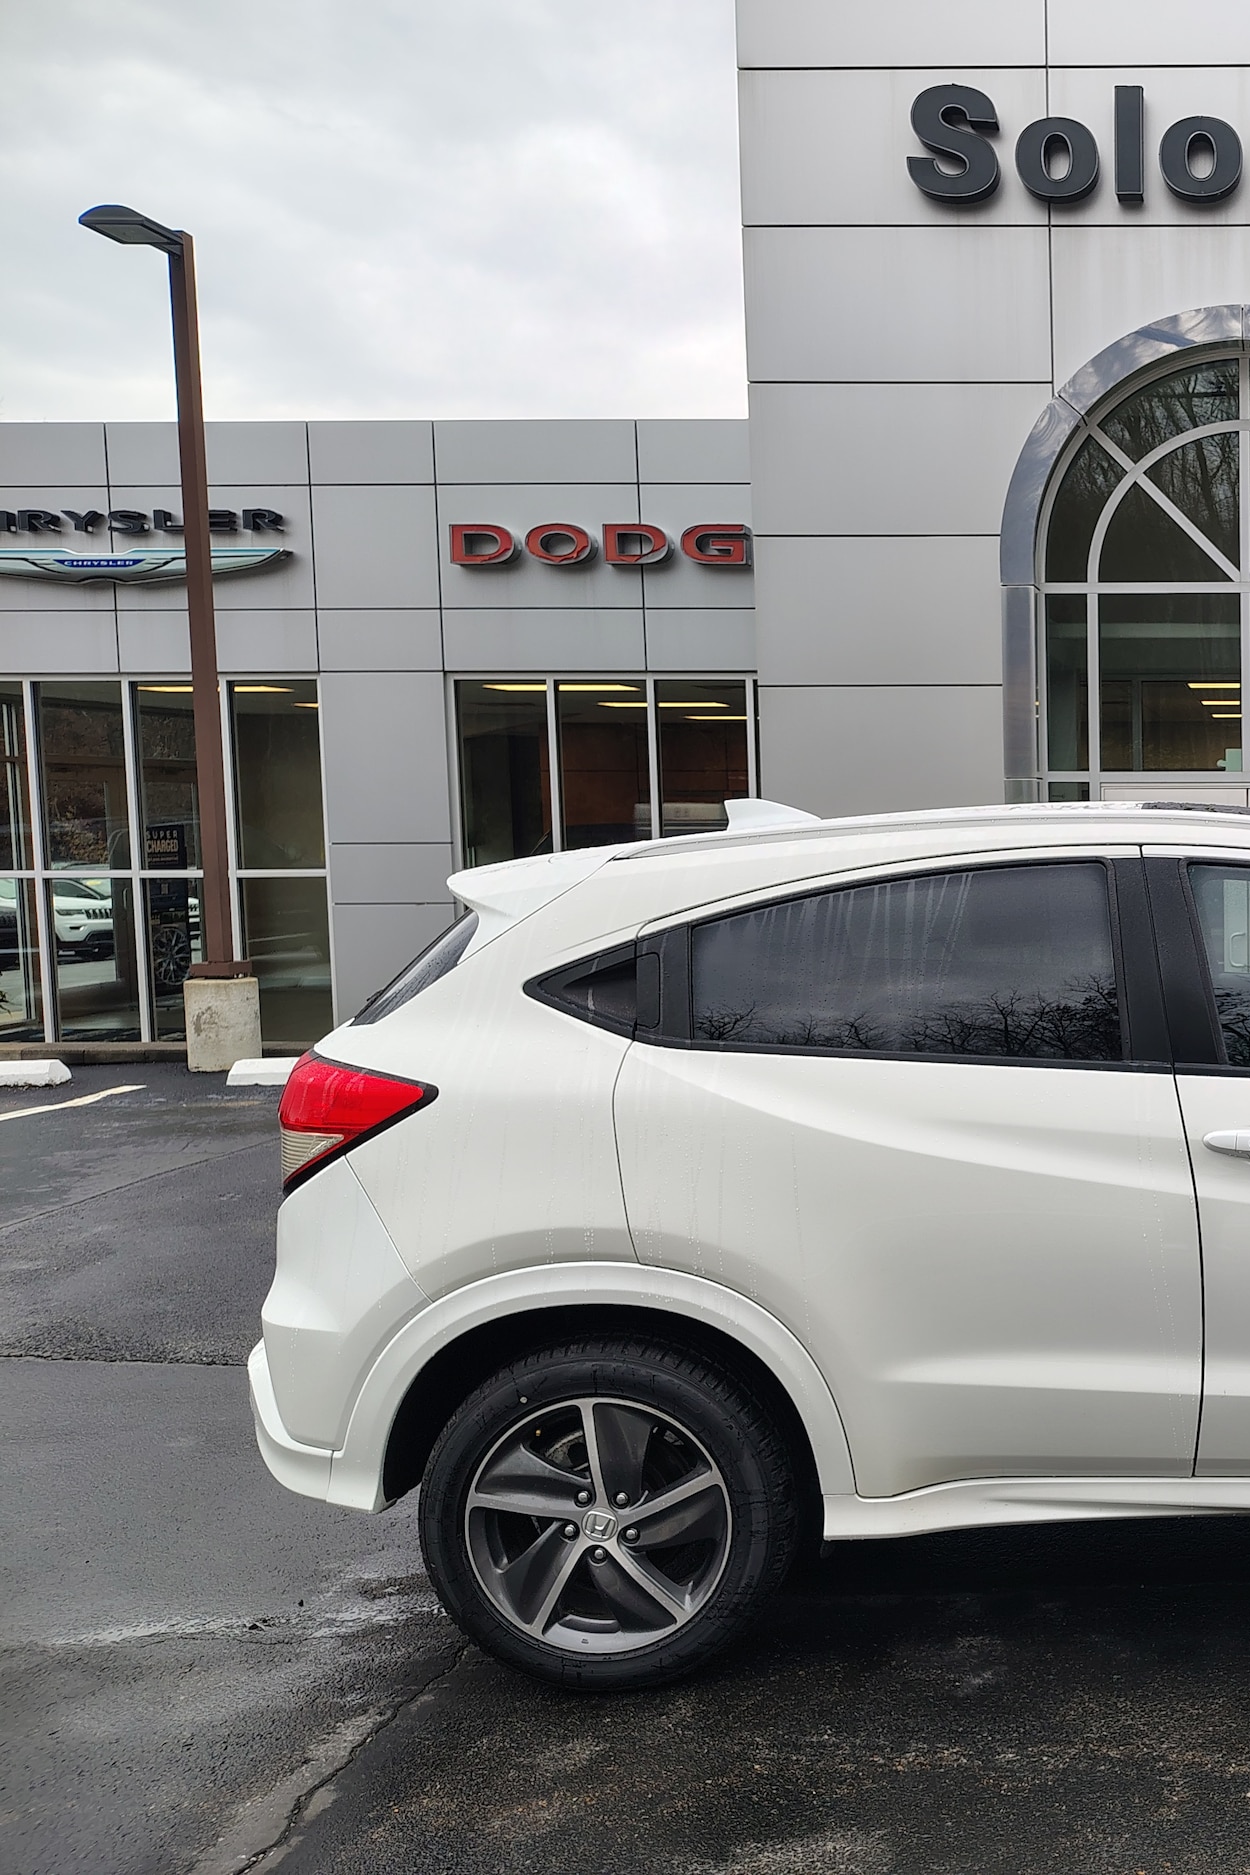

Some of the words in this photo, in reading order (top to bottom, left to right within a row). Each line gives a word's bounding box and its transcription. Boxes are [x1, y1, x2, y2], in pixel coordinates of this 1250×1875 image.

[0, 509, 286, 534] RYSLER
[449, 523, 753, 566] DODG
[146, 830, 178, 839] SUPER
[147, 839, 179, 853] CHARGED
